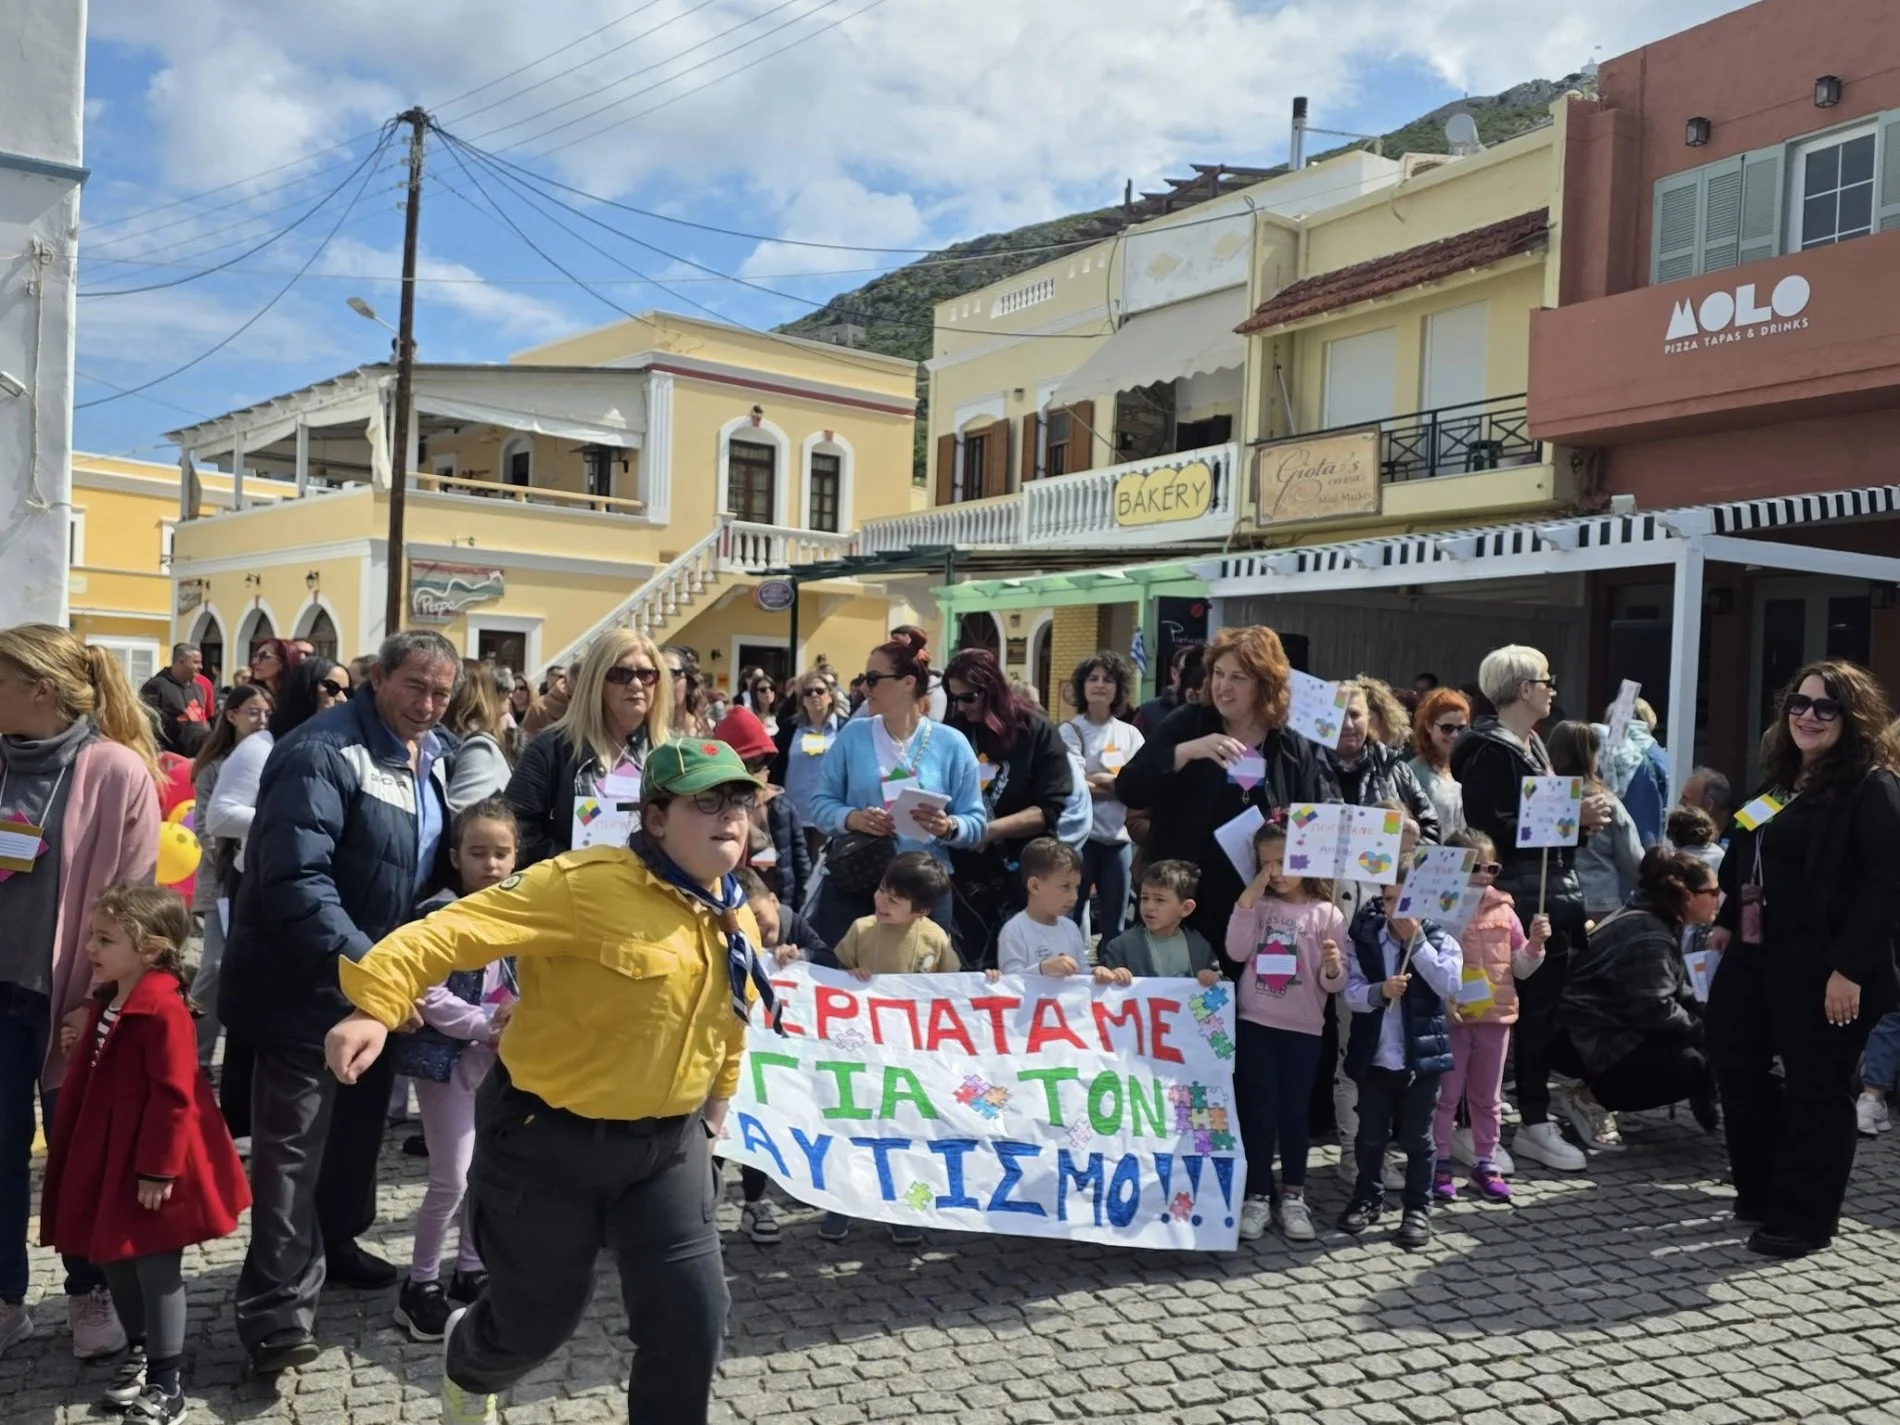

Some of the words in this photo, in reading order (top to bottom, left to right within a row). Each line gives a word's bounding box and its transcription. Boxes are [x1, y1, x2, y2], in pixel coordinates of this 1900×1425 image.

[1665, 275, 1811, 341] MOLO
[1665, 340, 1699, 354] PIZZA
[1704, 331, 1741, 348] TAPAS
[1747, 328, 1755, 338] &
[1760, 317, 1809, 336] DRINKS
[1118, 480, 1207, 516] BAKERY
[763, 979, 1186, 1064] ΕΡΠΑΤΑΜΕ
[750, 1051, 938, 1120] ΓΙΑ
[1017, 1066, 1167, 1139] ΤΟΝ
[738, 1111, 1235, 1229] ΑΥΤΙΣΜΟ!!!
